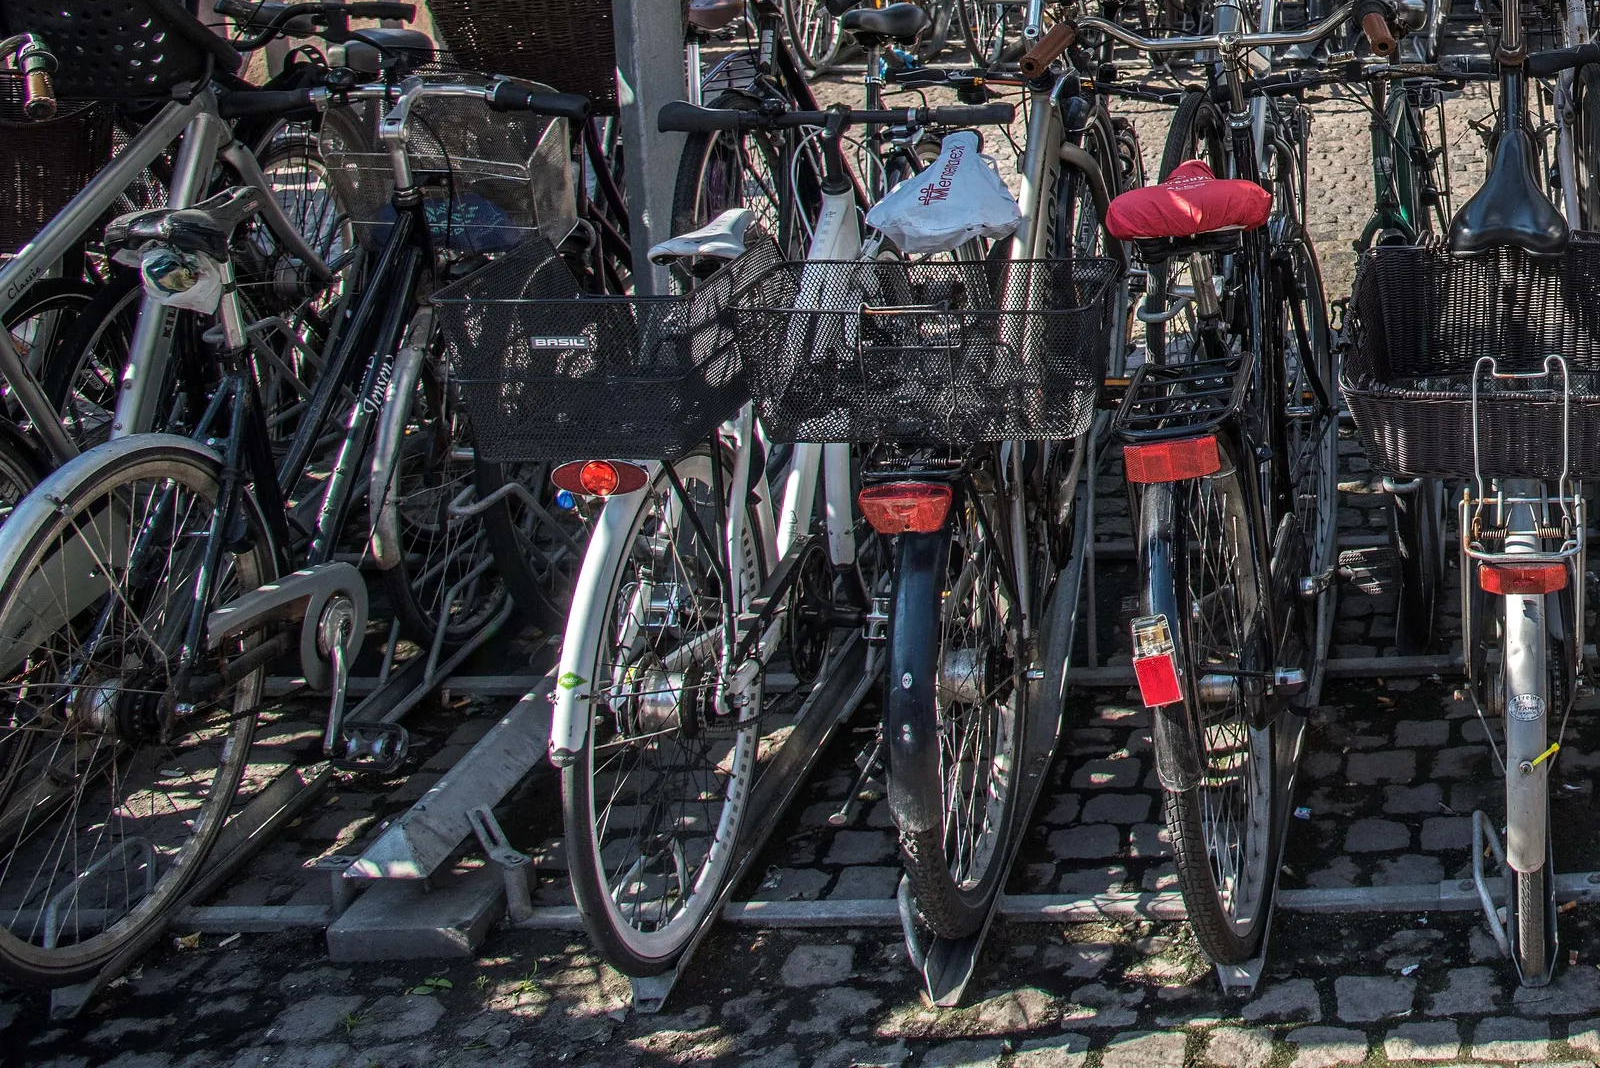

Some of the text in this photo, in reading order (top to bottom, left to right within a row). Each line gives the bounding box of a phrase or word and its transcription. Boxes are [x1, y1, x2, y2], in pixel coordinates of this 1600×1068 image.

[7, 266, 42, 300] Classic
[535, 338, 585, 347] BASIL
[362, 354, 394, 417] Jensen
